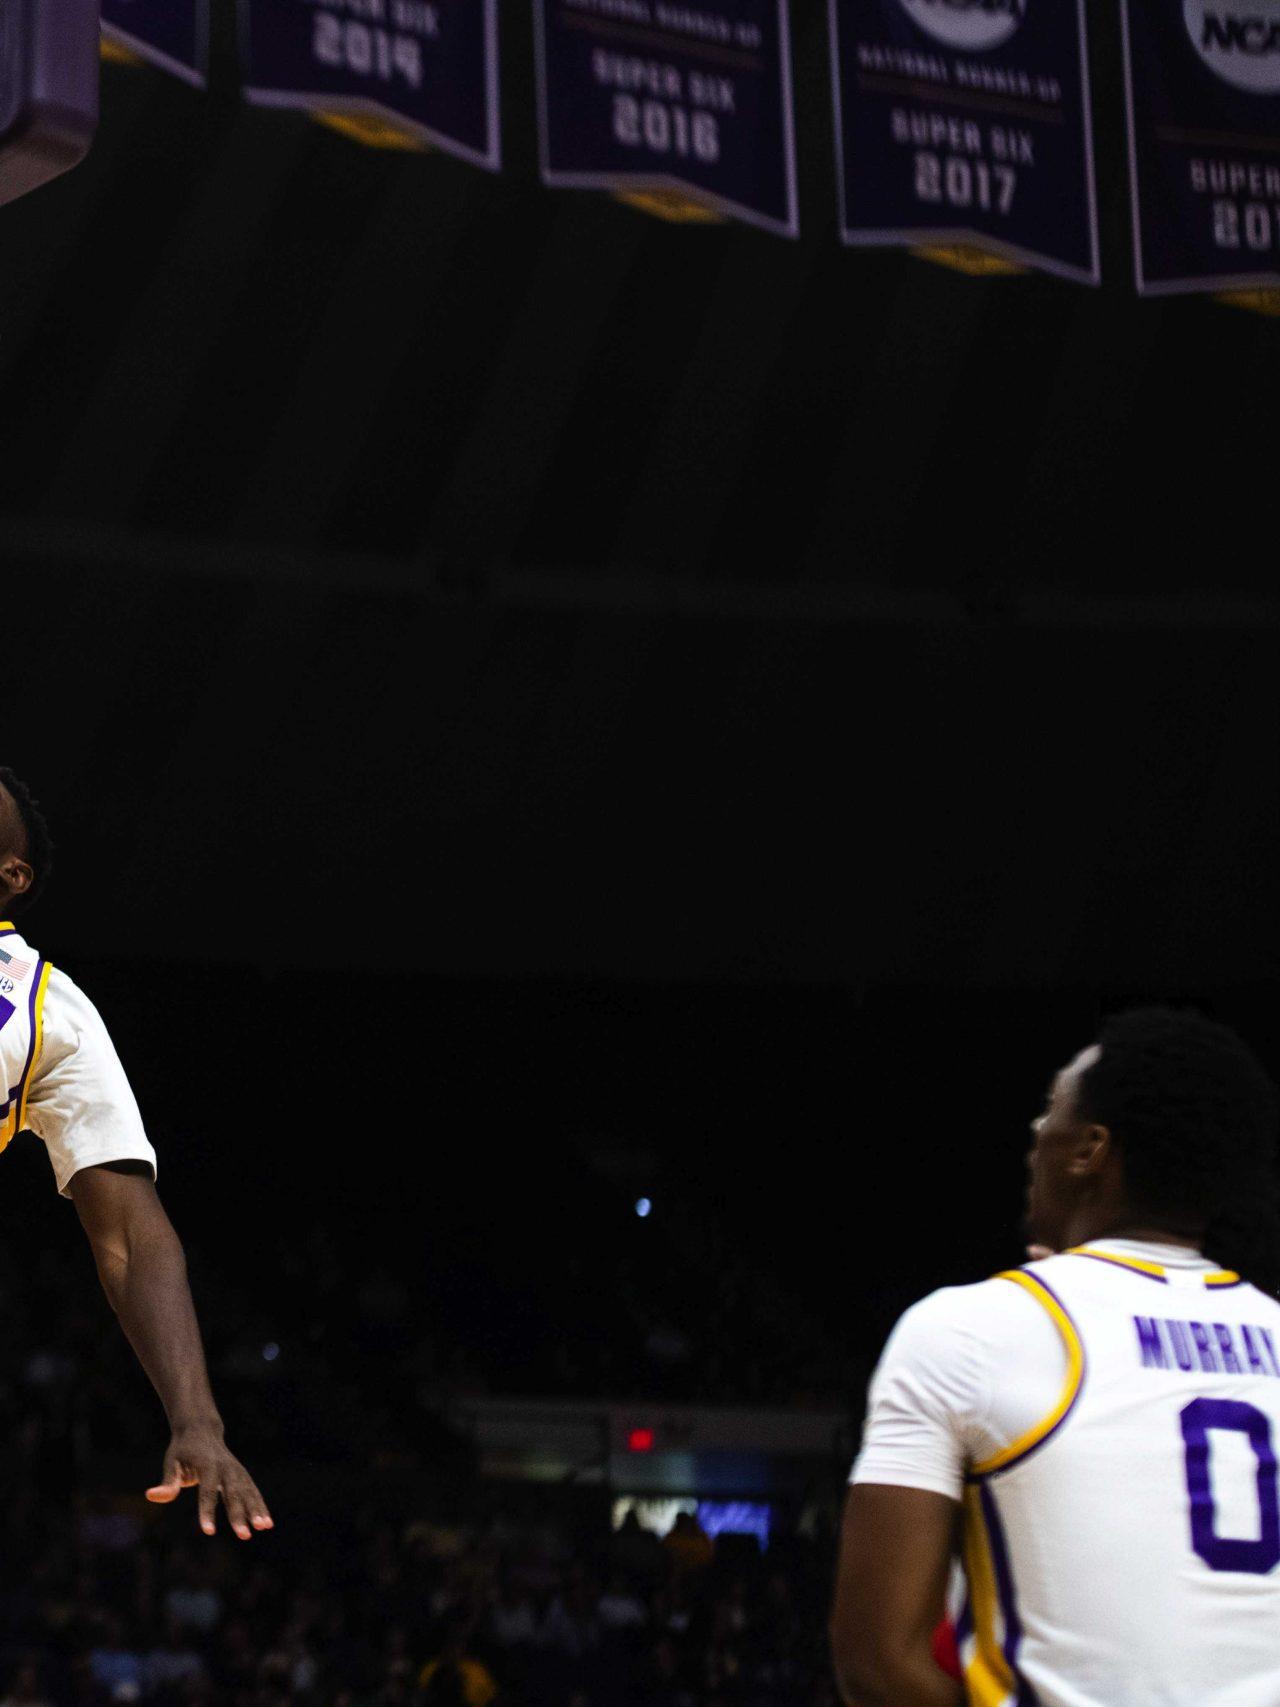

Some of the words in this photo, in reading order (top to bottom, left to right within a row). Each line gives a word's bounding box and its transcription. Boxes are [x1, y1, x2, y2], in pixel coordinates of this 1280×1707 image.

[890, 106, 982, 154] SUPER
[988, 124, 1035, 166] SIX
[913, 150, 1017, 216] 2017
[1213, 198, 1280, 250] 20
[1179, 1396, 1280, 1575] 0
